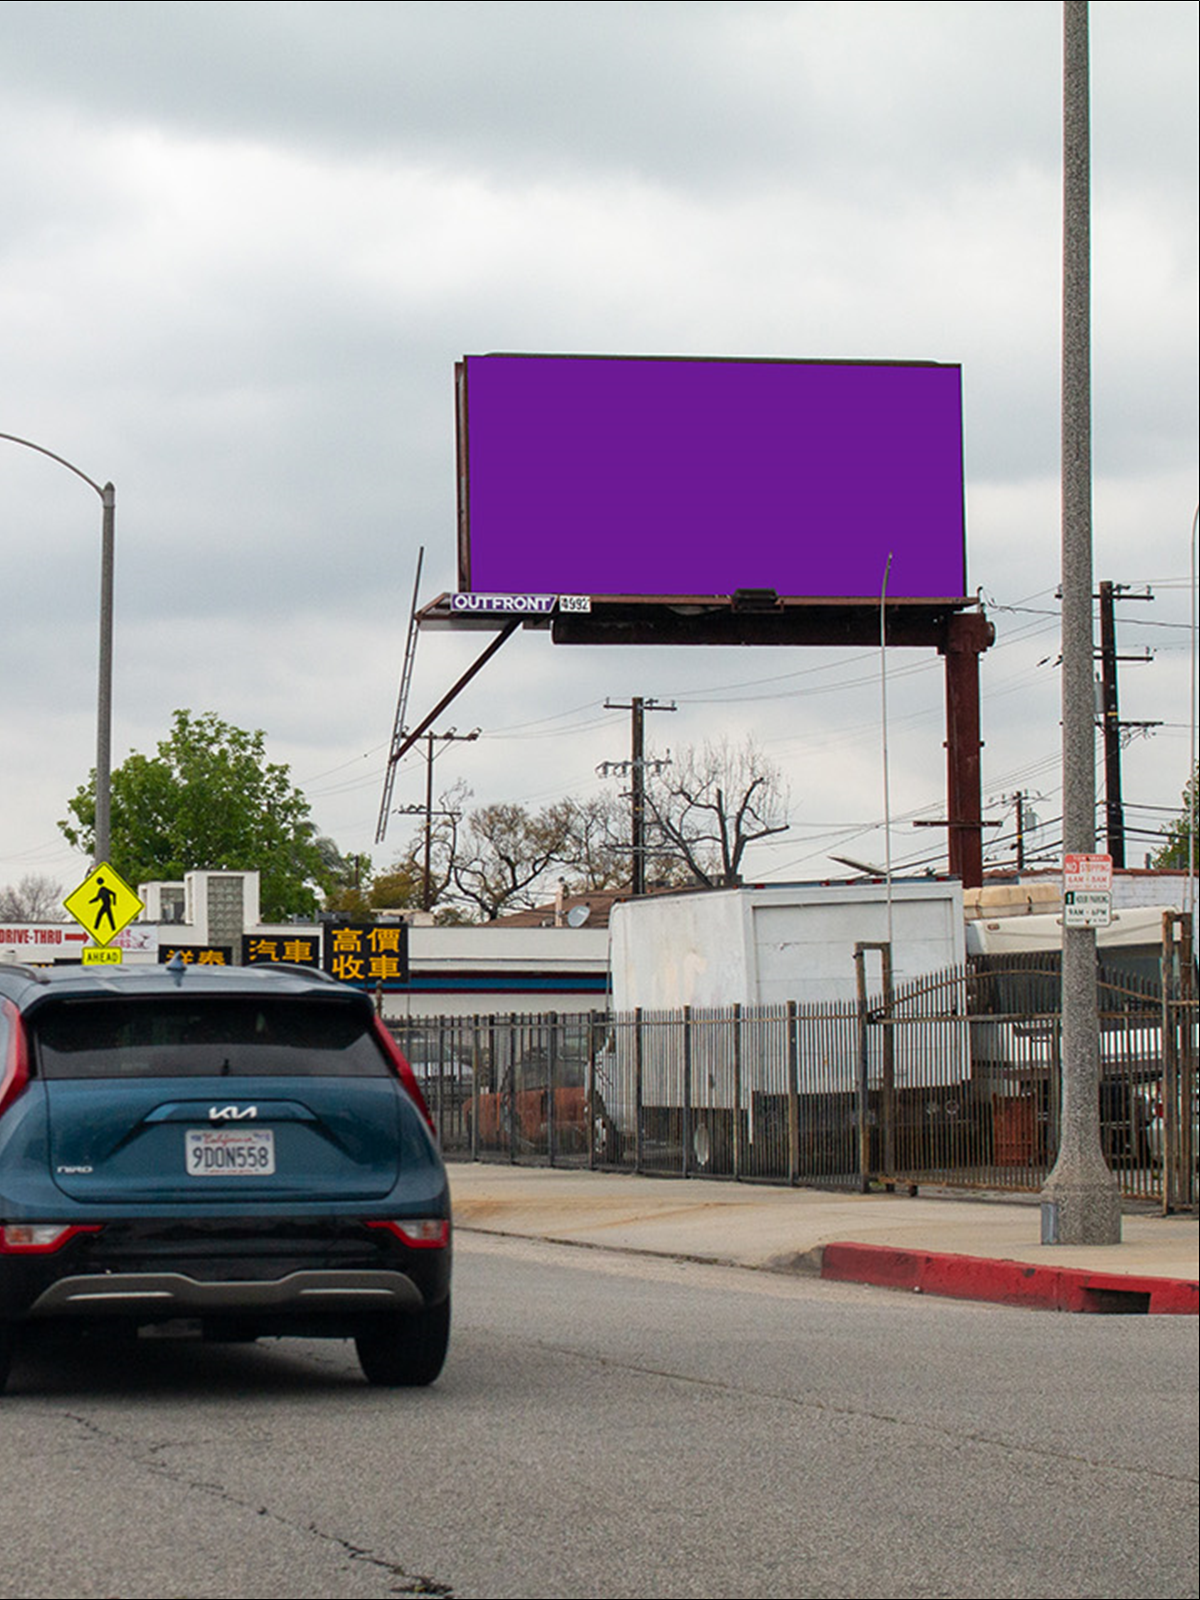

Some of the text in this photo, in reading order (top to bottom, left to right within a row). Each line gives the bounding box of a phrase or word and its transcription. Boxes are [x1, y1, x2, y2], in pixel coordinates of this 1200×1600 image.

[454, 595, 551, 610] OUTFRONT
[1065, 862, 1077, 872] NO
[331, 927, 402, 953] 高價
[86, 951, 118, 963] AHEAD
[249, 939, 314, 963] 汽車
[331, 954, 401, 980] 收車
[209, 1106, 257, 1119] KIA
